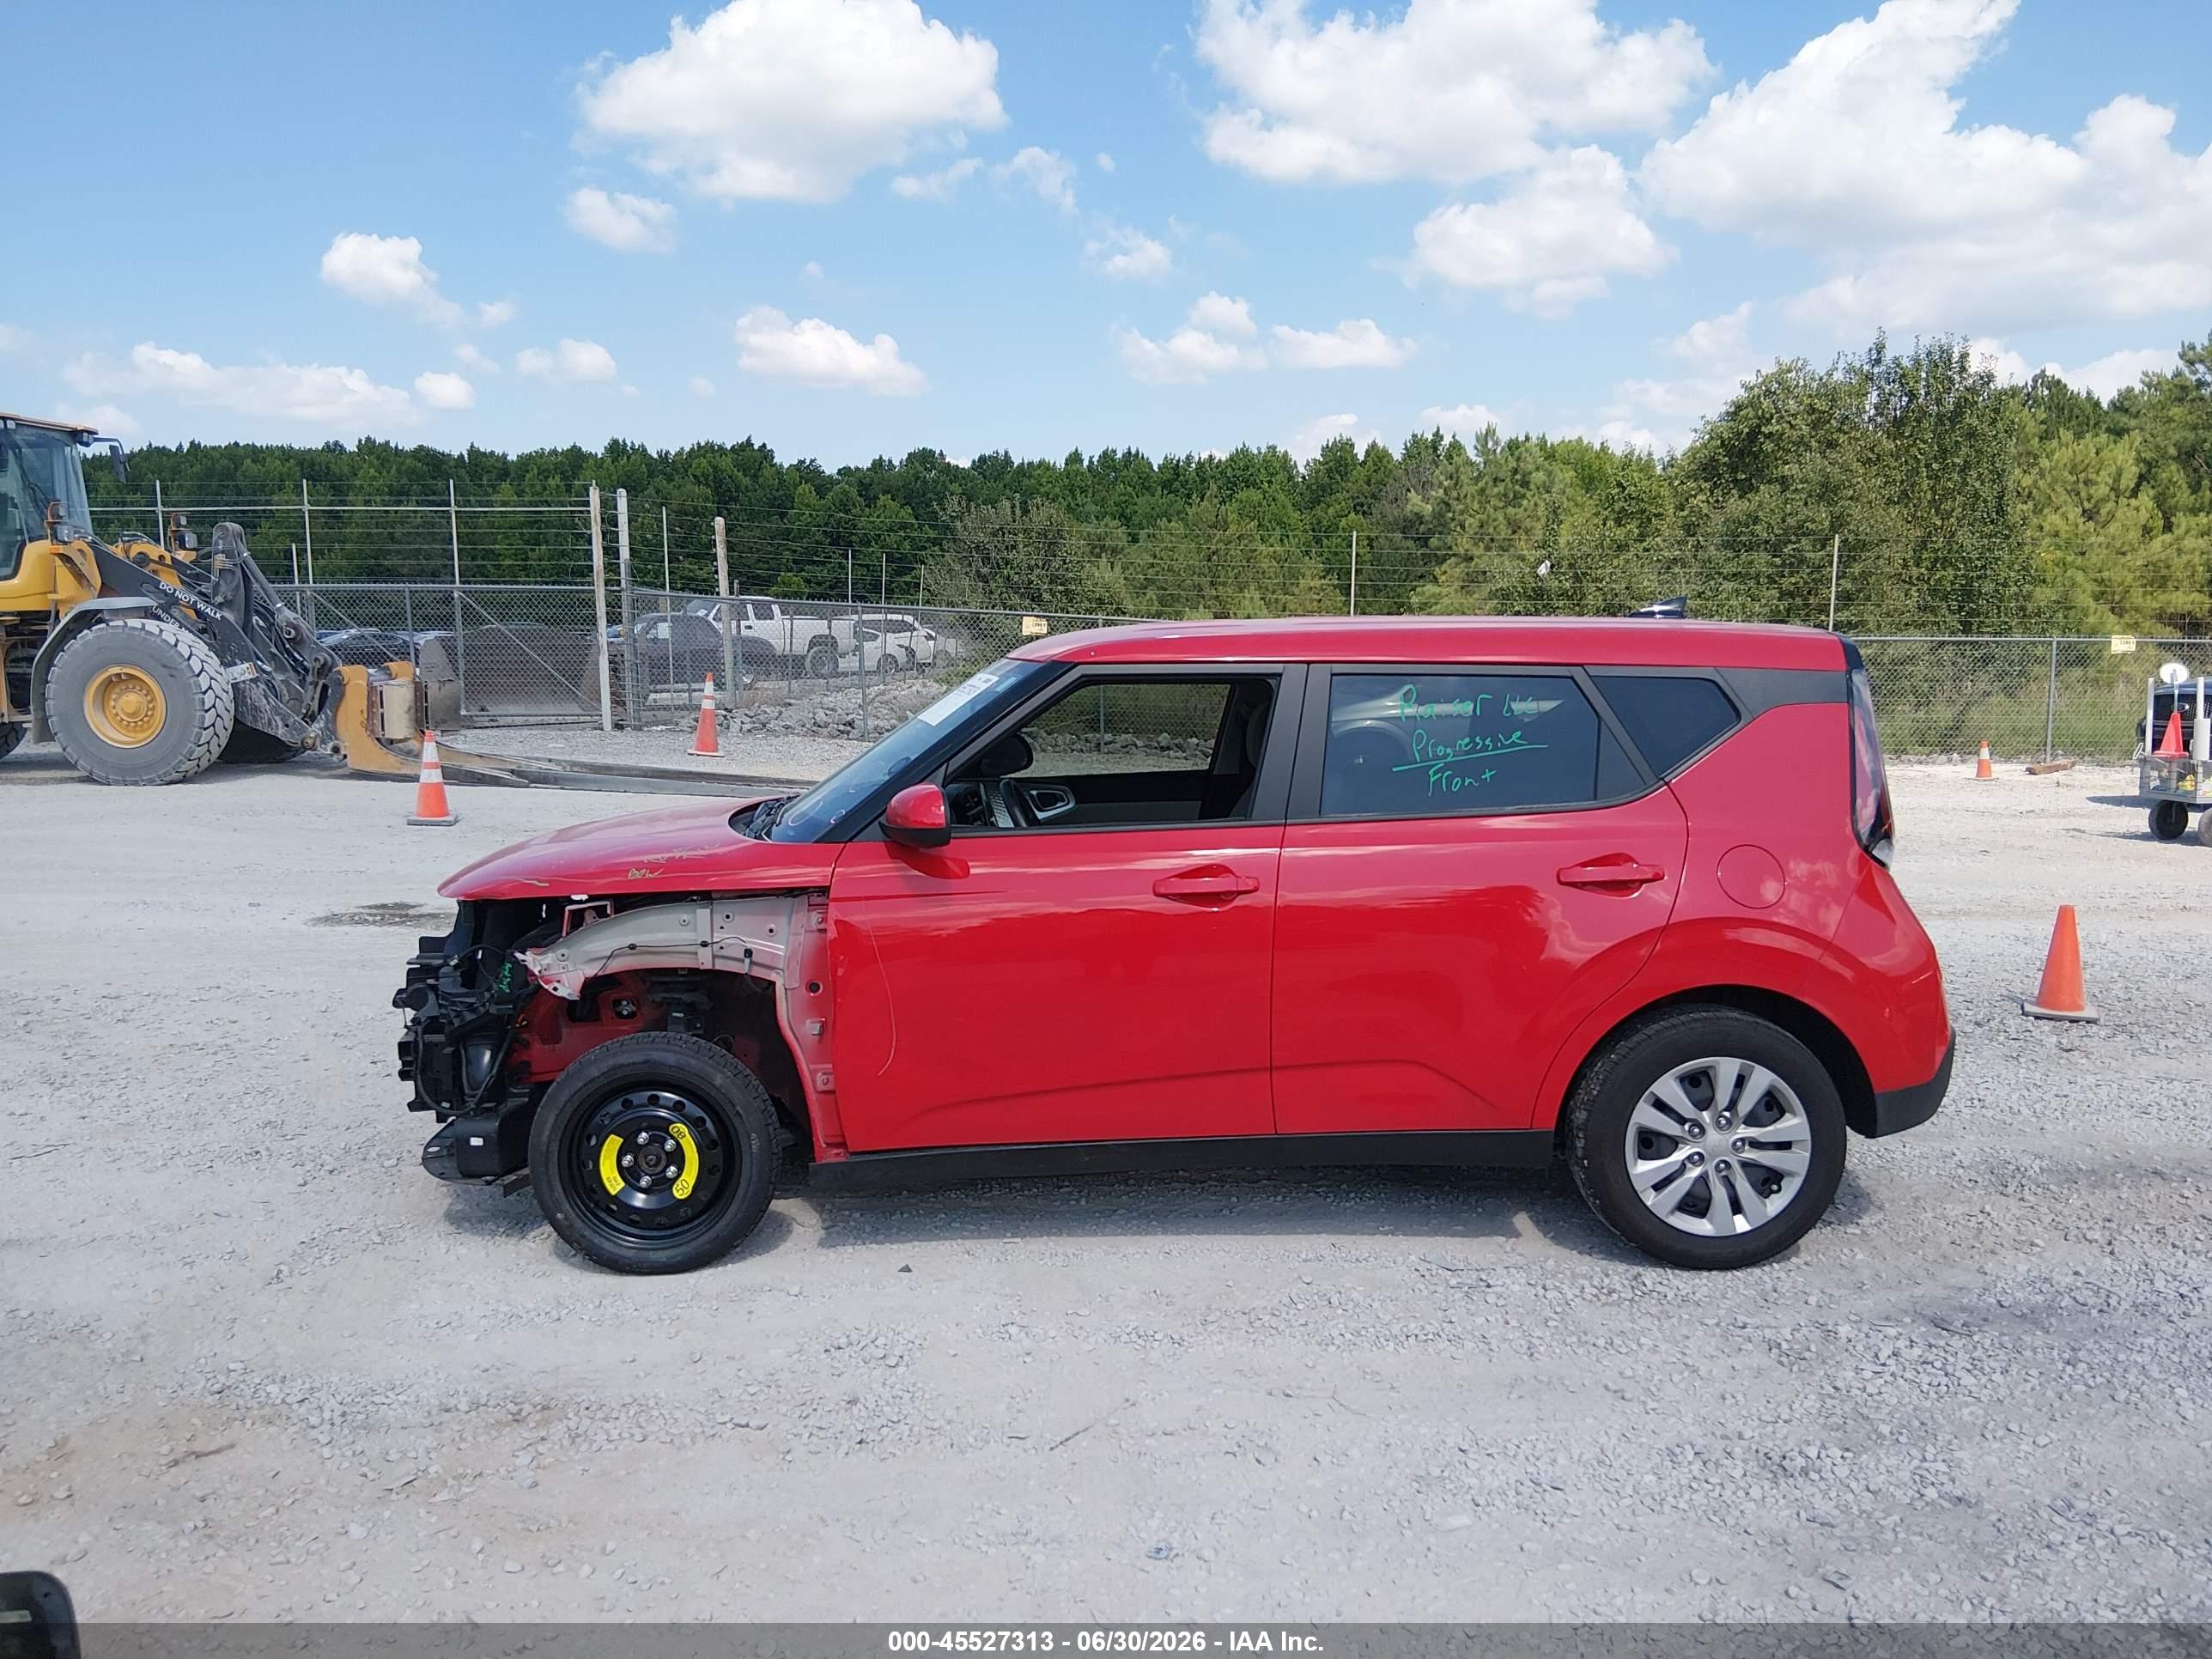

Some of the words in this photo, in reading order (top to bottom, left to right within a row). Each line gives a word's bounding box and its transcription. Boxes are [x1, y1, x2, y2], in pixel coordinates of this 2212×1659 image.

[159, 581, 173, 593] DO
[174, 590, 194, 605] NOT
[197, 603, 224, 620] WALK
[1413, 728, 1528, 763] Progressive
[1427, 763, 1498, 797] Front
[674, 1178, 690, 1197] 50
